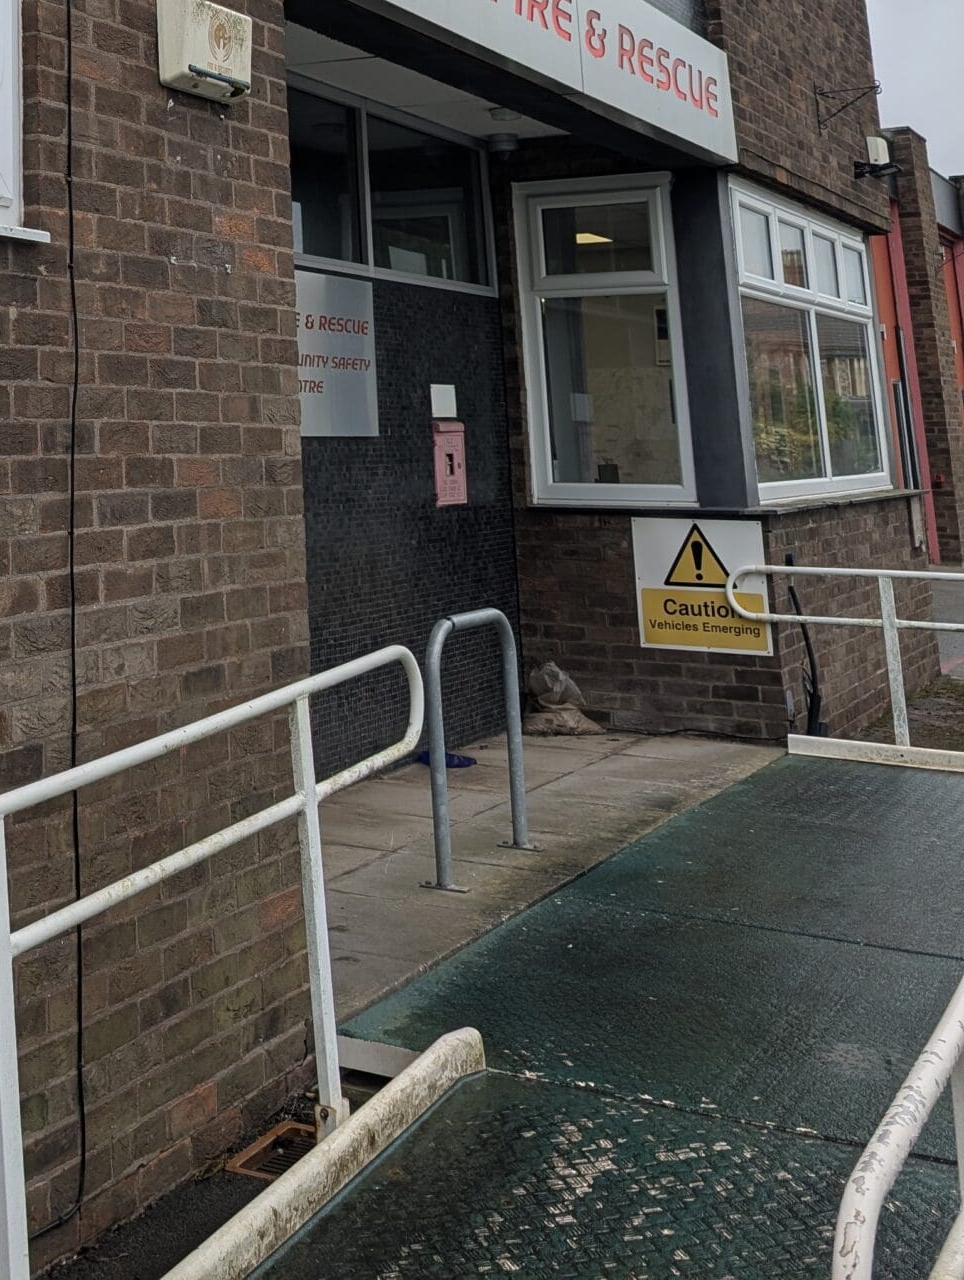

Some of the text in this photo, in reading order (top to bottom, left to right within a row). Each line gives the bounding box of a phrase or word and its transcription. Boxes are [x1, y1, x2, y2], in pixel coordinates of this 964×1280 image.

[585, 9, 608, 59] &
[617, 23, 719, 118] RESCUE
[305, 314, 314, 330] &
[318, 315, 369, 336] RESCUE
[331, 356, 371, 372] SAFETY
[649, 619, 761, 638] Vehicles Emerging
